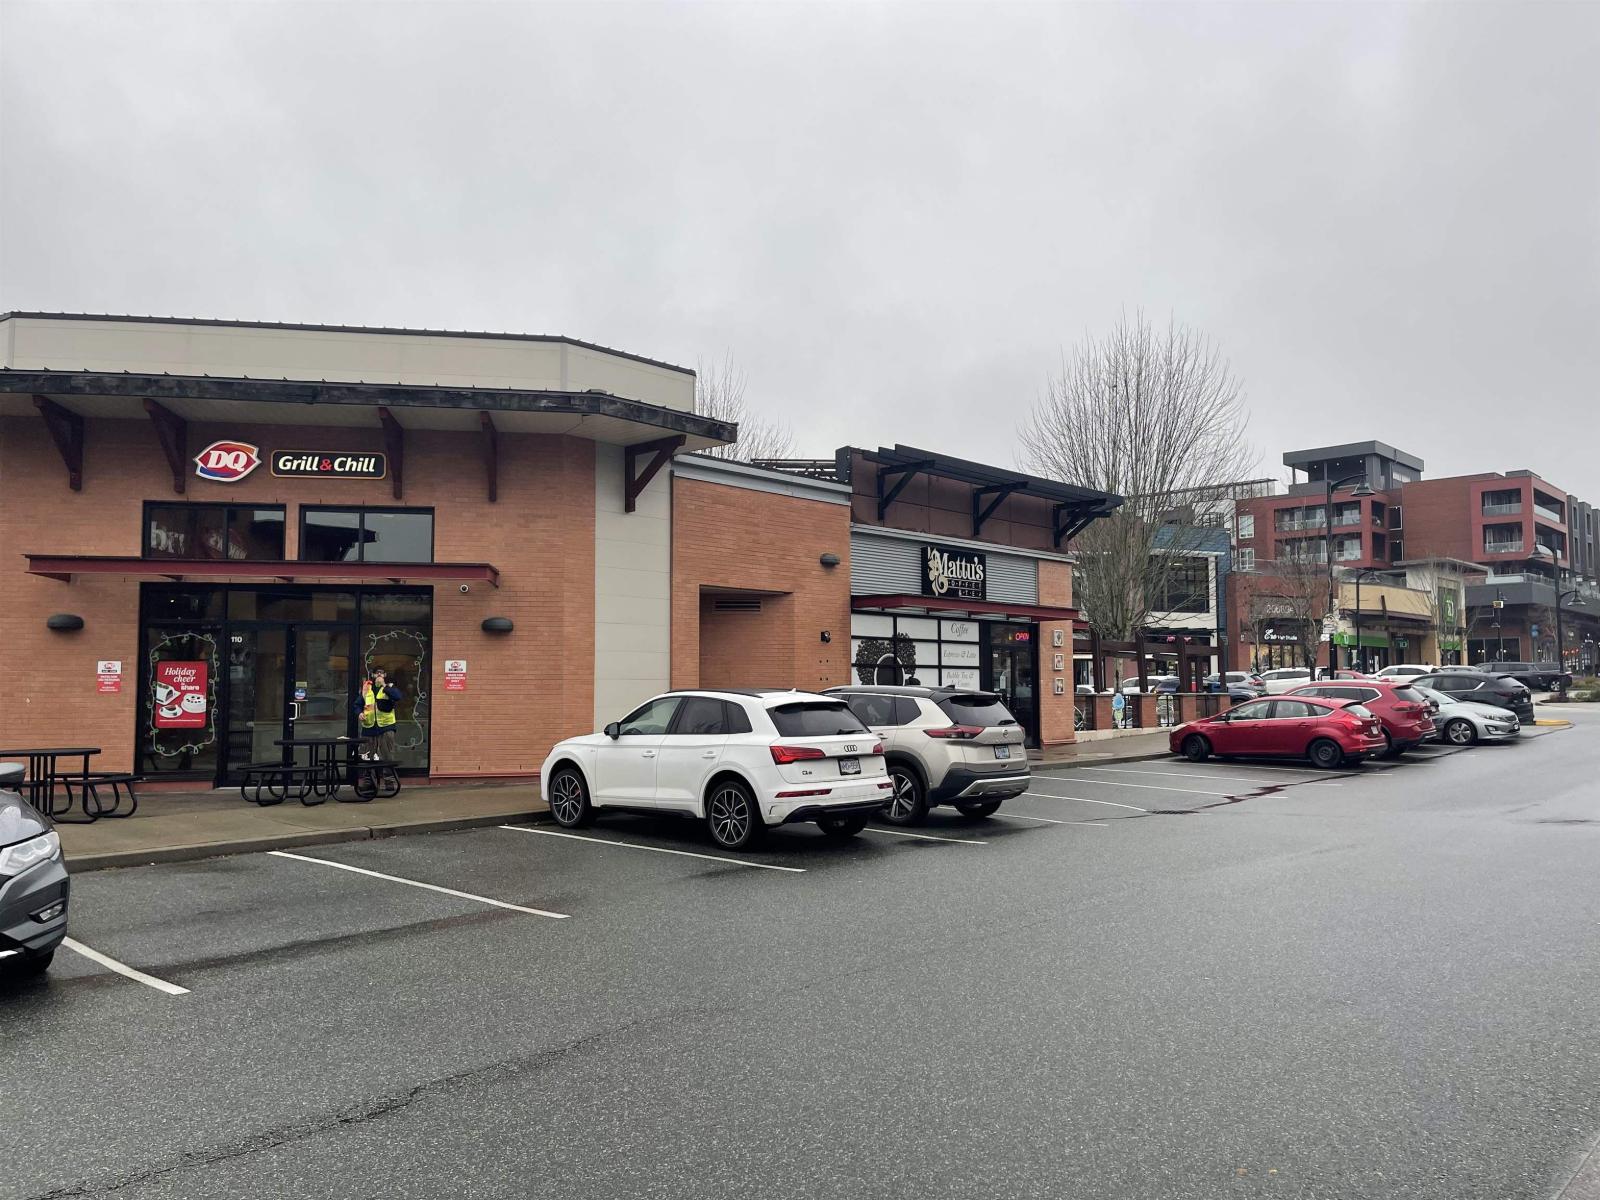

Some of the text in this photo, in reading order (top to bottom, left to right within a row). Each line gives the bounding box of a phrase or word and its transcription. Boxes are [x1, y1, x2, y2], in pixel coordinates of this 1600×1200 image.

[207, 450, 248, 472] DQ
[930, 550, 984, 581] Mattu's
[1015, 632, 1030, 641] OPEN
[165, 667, 197, 677] Holiday
[173, 675, 196, 683] cheer
